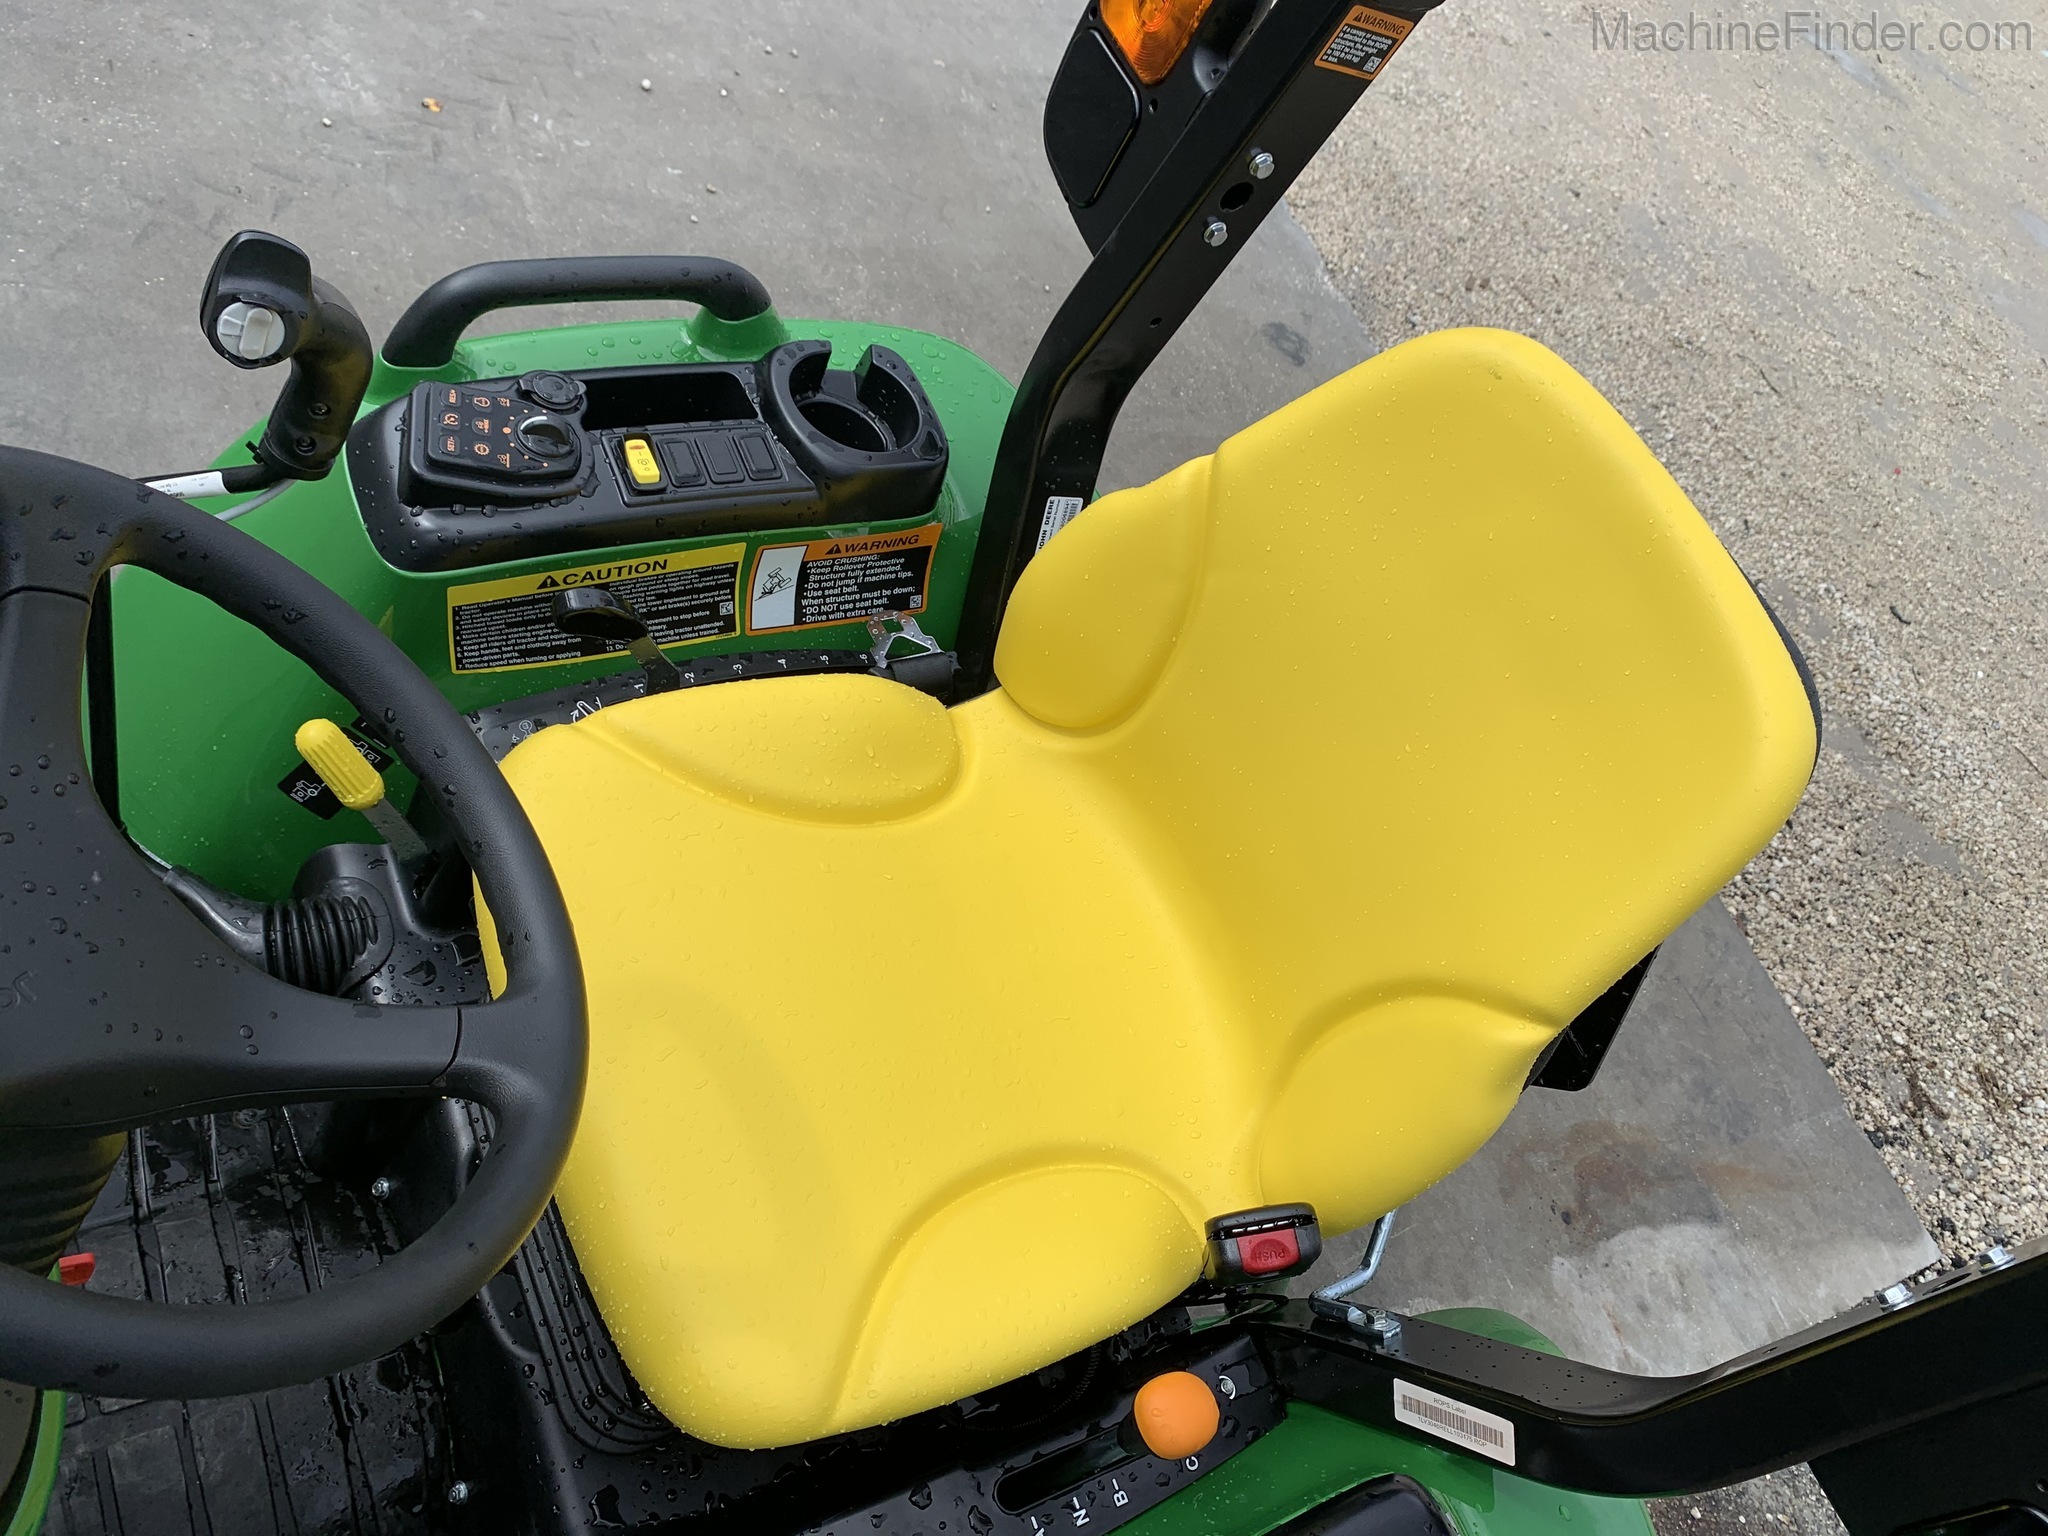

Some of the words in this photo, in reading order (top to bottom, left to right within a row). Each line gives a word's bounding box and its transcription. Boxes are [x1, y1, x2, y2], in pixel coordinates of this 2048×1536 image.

[1361, 14, 1405, 35] WARNING
[1039, 530, 1048, 550] OHN
[1044, 500, 1055, 525] DEERE
[845, 534, 920, 553] WARNING
[810, 566, 831, 575] Keep
[832, 562, 865, 571] Rollover
[867, 558, 905, 567] Protective
[835, 554, 880, 564] CRUSHING:
[562, 559, 668, 586] CAUTION
[809, 572, 846, 581] Structure
[847, 569, 864, 578] fully
[866, 565, 902, 574] extended.
[864, 573, 896, 582] machine
[897, 570, 914, 579] tips.
[668, 601, 690, 610] brake(s)
[691, 597, 714, 606] securely
[801, 597, 824, 606] When
[825, 593, 860, 602] structure
[892, 586, 916, 596] down;
[805, 614, 827, 622] Drive
[654, 630, 674, 638] leaving
[694, 621, 725, 630] unattended.
[527, 641, 551, 649] clothing
[657, 635, 680, 643] machine
[462, 654, 501, 664] power-driven
[556, 651, 581, 659] applying
[1254, 1248, 1286, 1262] PUSH
[1434, 1398, 1450, 1409] ROPS
[1452, 1404, 1466, 1415] Label
[1186, 1456, 1199, 1471] C
[1112, 1490, 1129, 1508] B
[1072, 1508, 1090, 1528] N
